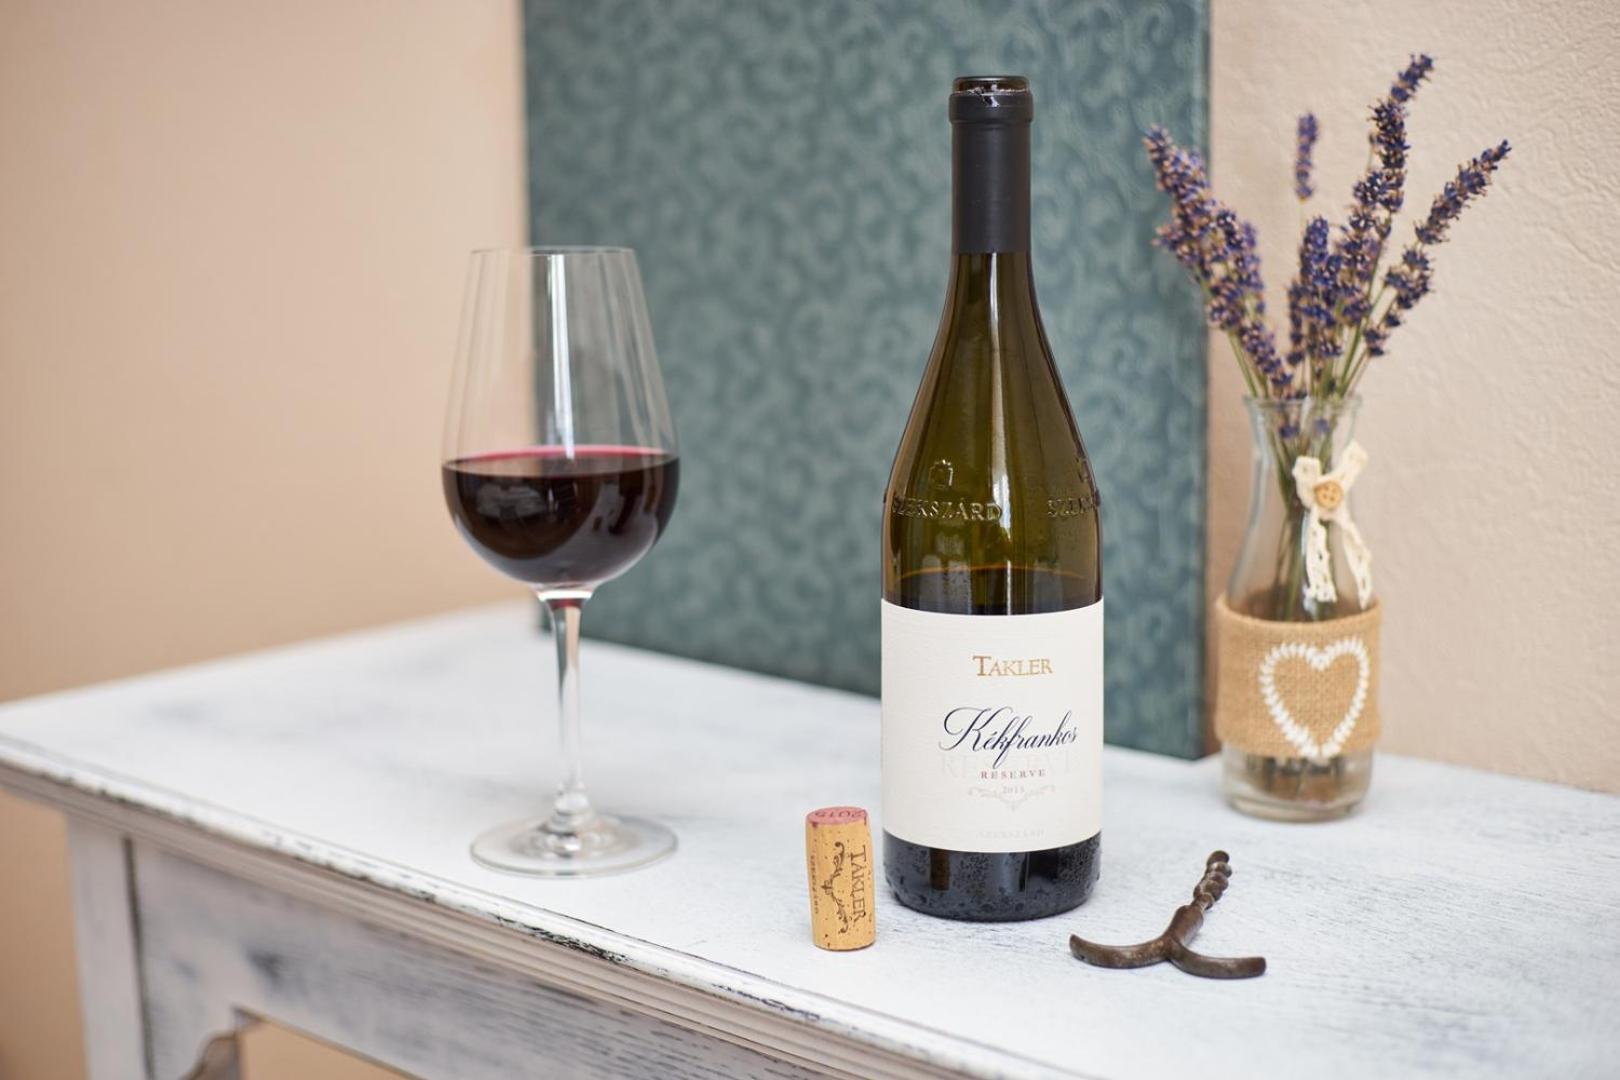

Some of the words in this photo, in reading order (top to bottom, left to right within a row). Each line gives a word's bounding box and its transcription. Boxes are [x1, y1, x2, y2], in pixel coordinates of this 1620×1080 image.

[972, 655, 1053, 677] TAKLER
[938, 706, 1078, 769] Kékfrankos
[980, 768, 1047, 780] RESERVE
[849, 844, 868, 926] TAKLER
